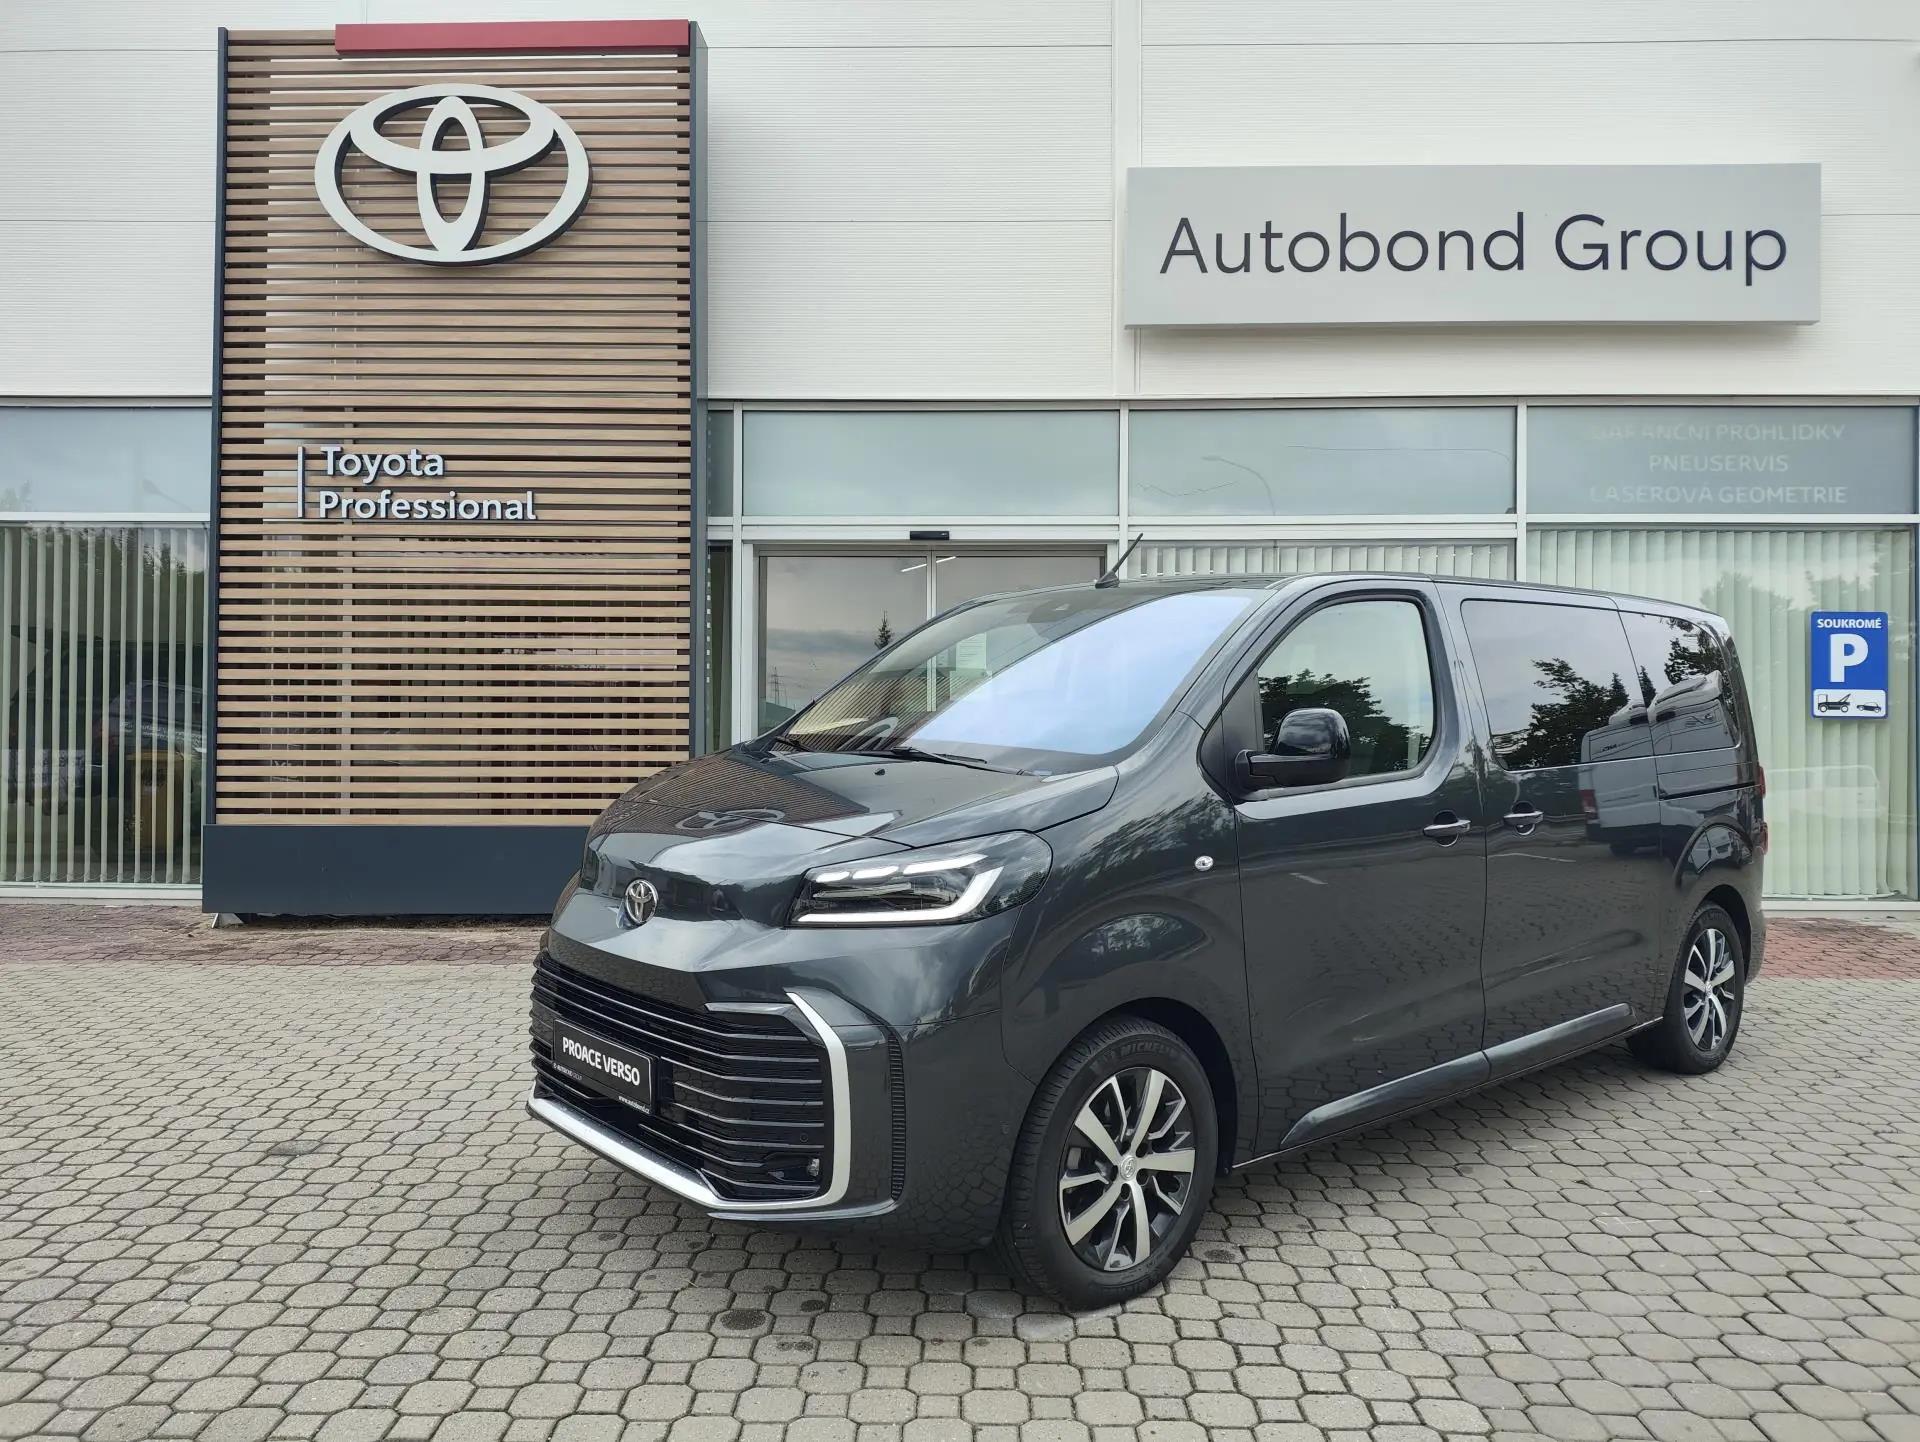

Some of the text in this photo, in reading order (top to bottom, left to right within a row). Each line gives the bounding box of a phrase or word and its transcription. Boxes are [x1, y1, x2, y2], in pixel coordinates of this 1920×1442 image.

[1159, 211, 1788, 287] Autobond Group
[320, 446, 445, 485] Toyota
[1649, 454, 1790, 473] PNEUSERVIS
[319, 489, 537, 520] Professional
[1718, 485, 1849, 504] GEOMETRIE
[1817, 616, 1883, 630] SOUKROMÉ
[1829, 632, 1869, 684] P
[562, 1037, 640, 1085] PROACE VERSO
